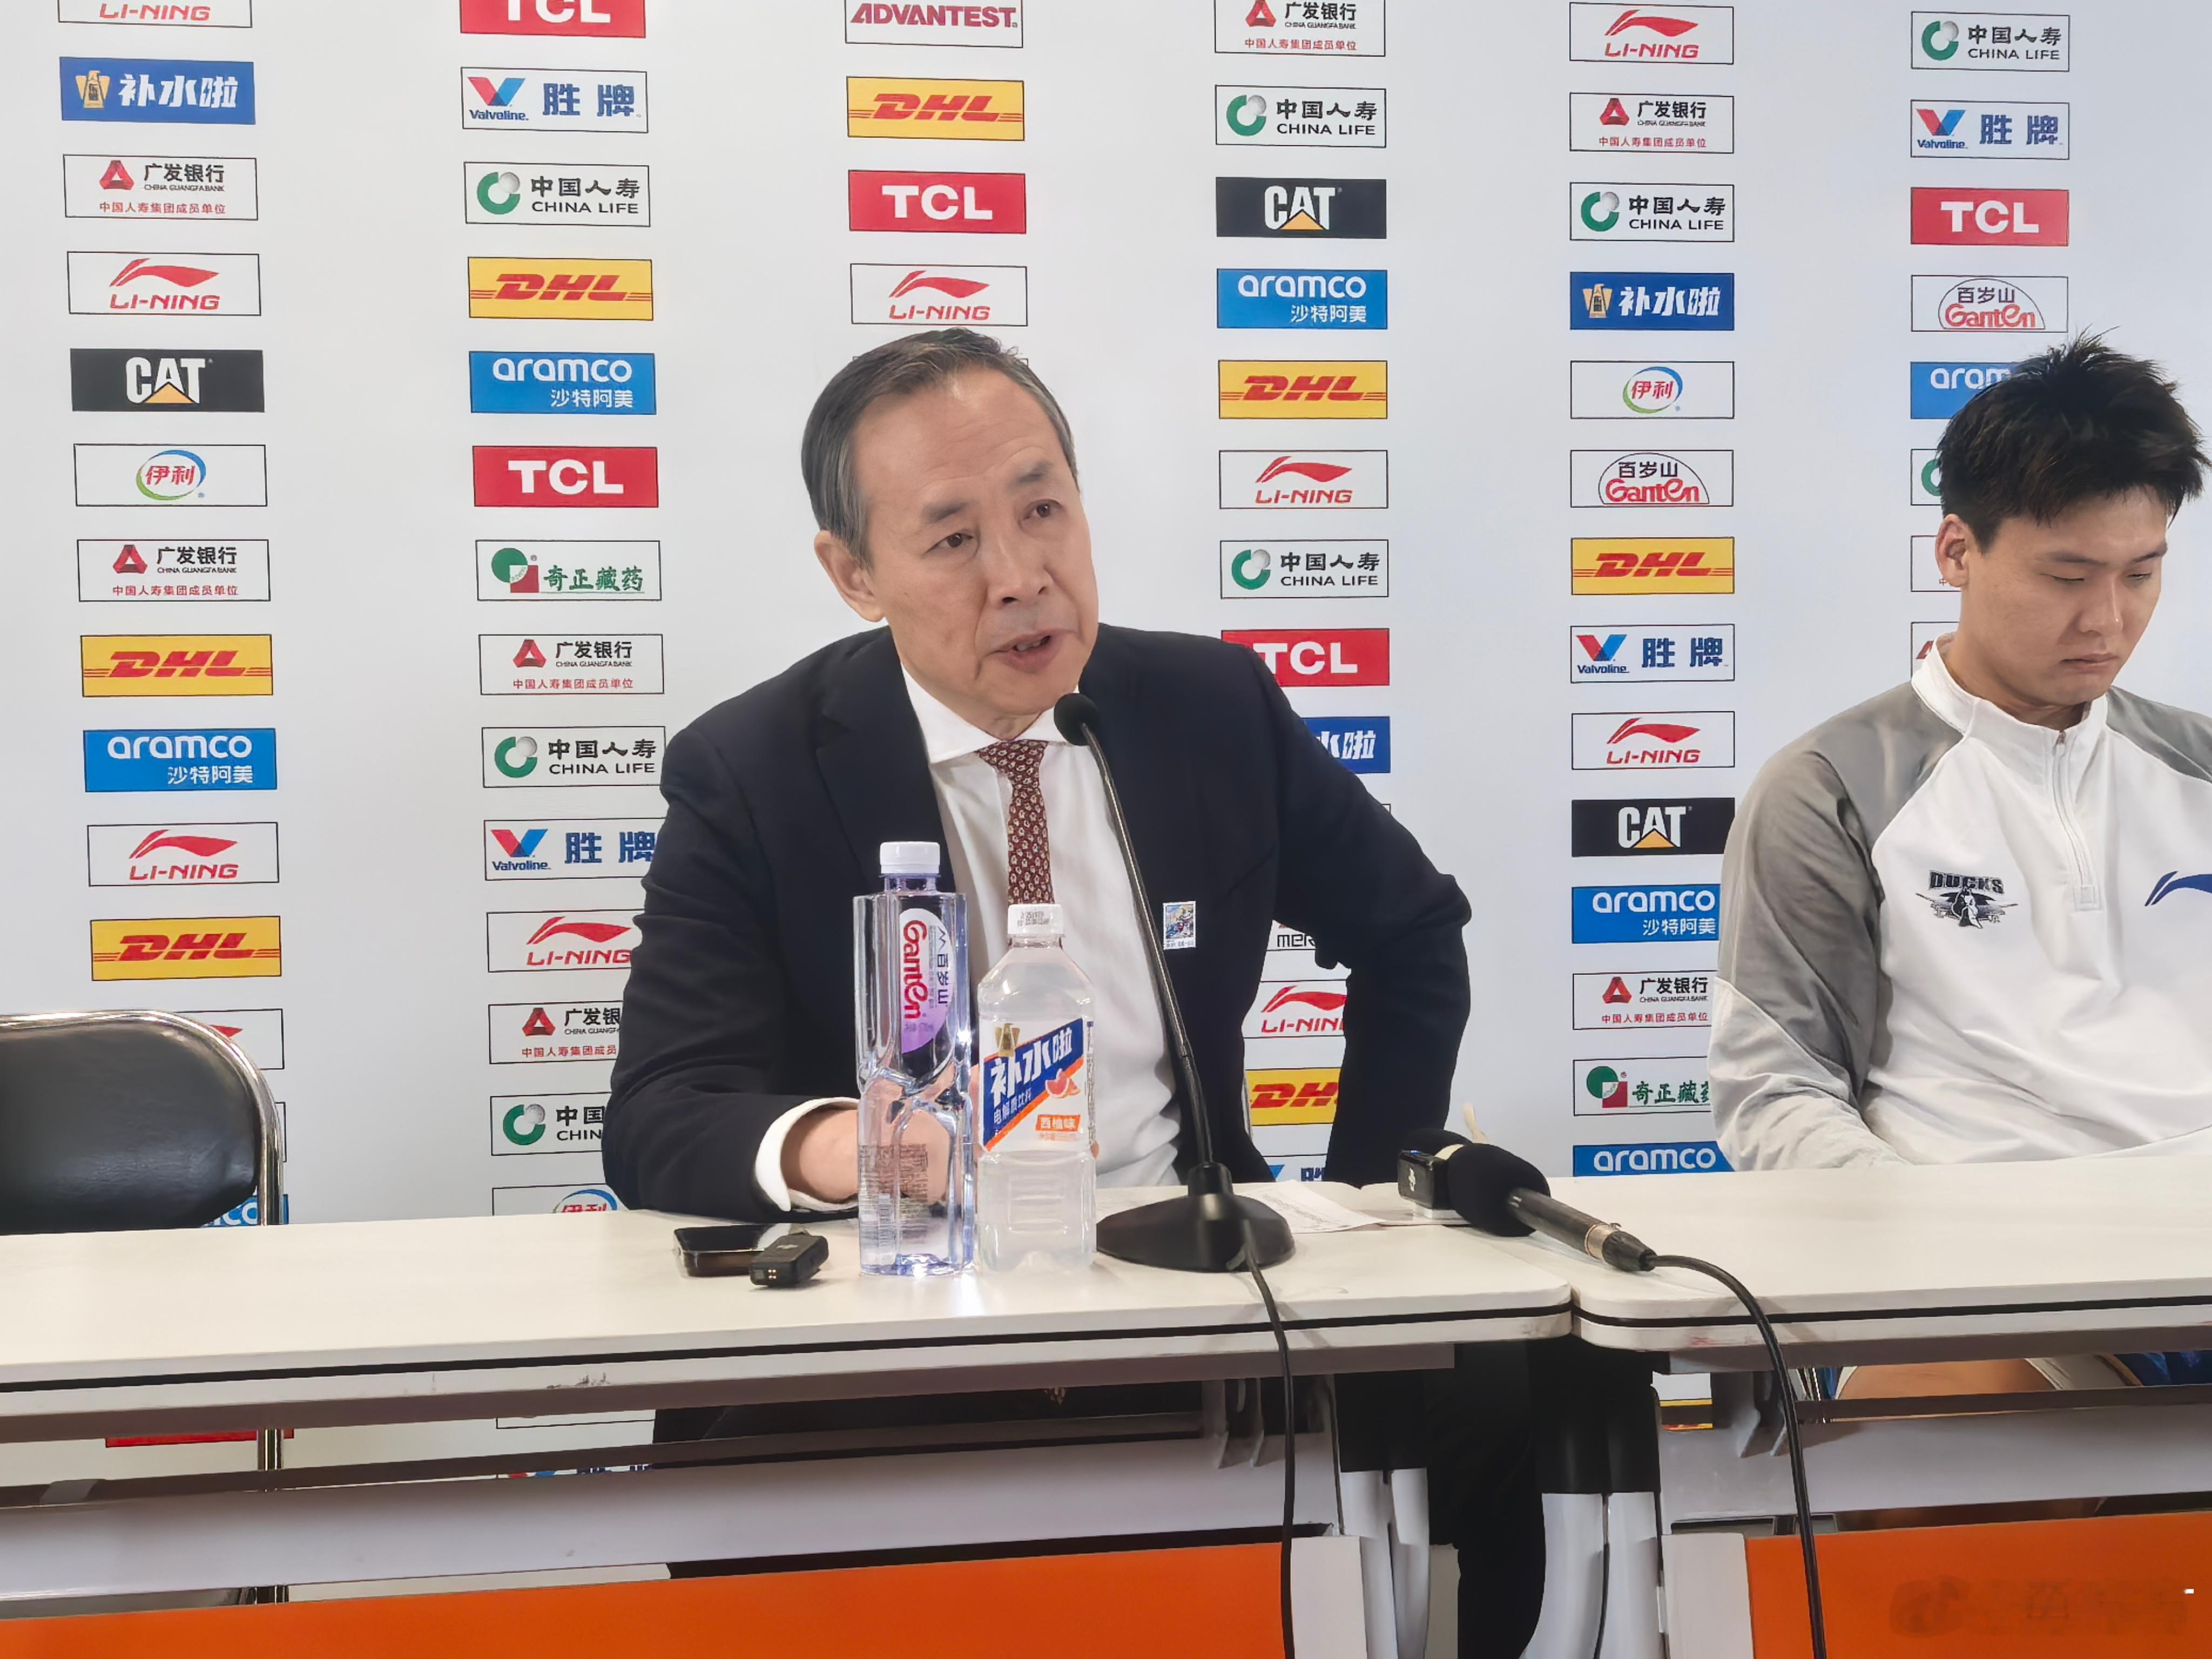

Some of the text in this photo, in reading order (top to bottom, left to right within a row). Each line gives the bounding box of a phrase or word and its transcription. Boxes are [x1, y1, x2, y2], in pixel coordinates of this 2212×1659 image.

[99, 3, 211, 21] LI-NING
[851, 3, 1016, 28] ADVANTEST
[1285, 2, 1356, 21] 广发银行
[1968, 25, 2061, 46] 中国人寿
[1605, 43, 1699, 58] LI-NING
[1968, 49, 2060, 60] CHINA LIFE
[118, 73, 238, 108] 补水啦
[542, 83, 634, 117] 胜牌
[873, 93, 1000, 122] DHL
[1276, 99, 1377, 120] 中国人寿
[1638, 101, 1706, 118] 广发银行
[1277, 124, 1375, 136] CHINA LIFE
[1980, 114, 2058, 145] 胜牌
[144, 163, 224, 183] 广发银行
[531, 177, 640, 198] 中国人寿
[99, 201, 226, 215] 中国人寿集团成员单位
[532, 201, 639, 214] CHINA LIFE
[882, 185, 993, 220] TCL
[1264, 185, 1336, 230] CAT
[1629, 195, 1725, 215] 中国人寿
[1629, 219, 1724, 230] CHINA LIFE
[1941, 200, 2039, 234] TCL
[495, 274, 627, 301] DHL
[1238, 275, 1366, 298] aramco
[1958, 287, 2015, 304] 百岁山
[109, 294, 220, 309] LI-NING
[1618, 287, 1722, 316] 补水啦
[889, 305, 990, 320] LI-NING
[1291, 305, 1367, 323] 沙特阿美
[493, 358, 632, 382] aramco
[125, 357, 205, 404] CAT
[1243, 375, 1365, 401] DHL
[1631, 381, 1674, 399] 伊利
[551, 389, 633, 408] 沙特阿美
[145, 465, 195, 485] 伊利
[508, 459, 624, 495] TCL
[1618, 462, 1677, 478] 百岁山
[1256, 490, 1352, 504] LI-NING
[157, 547, 237, 565] 广发银行
[1280, 552, 1380, 572] 中国人寿
[1594, 552, 1711, 577] DHL
[543, 565, 643, 591] 奇正藏药
[1280, 575, 1378, 586] CHINA LIFE
[113, 585, 238, 596] 中国人寿集团成员单位
[556, 642, 632, 659] 广发银行
[1252, 641, 1358, 675] TCL
[1642, 638, 1723, 667] 胜牌
[109, 650, 245, 678] DHL
[107, 736, 252, 759] aramco
[548, 739, 657, 760] 中国人寿
[1607, 749, 1701, 764] LI-NING
[167, 765, 253, 785] 沙特阿美
[549, 763, 655, 774] CHINA LIFE
[1618, 806, 1686, 848] CAT
[129, 864, 239, 880] LI-NING
[1929, 871, 2004, 893] DUCKS
[1593, 890, 1715, 913] aramco
[1643, 918, 1716, 935] 沙特阿美
[119, 933, 253, 961] DHL
[527, 949, 632, 966] LI-NING
[1640, 977, 1708, 994] 广发银行
[1261, 1017, 1344, 1033] LI-NIN
[991, 1027, 1072, 1108] 补水啦
[1251, 1082, 1338, 1109] DH
[1594, 1148, 1716, 1171] aramco
